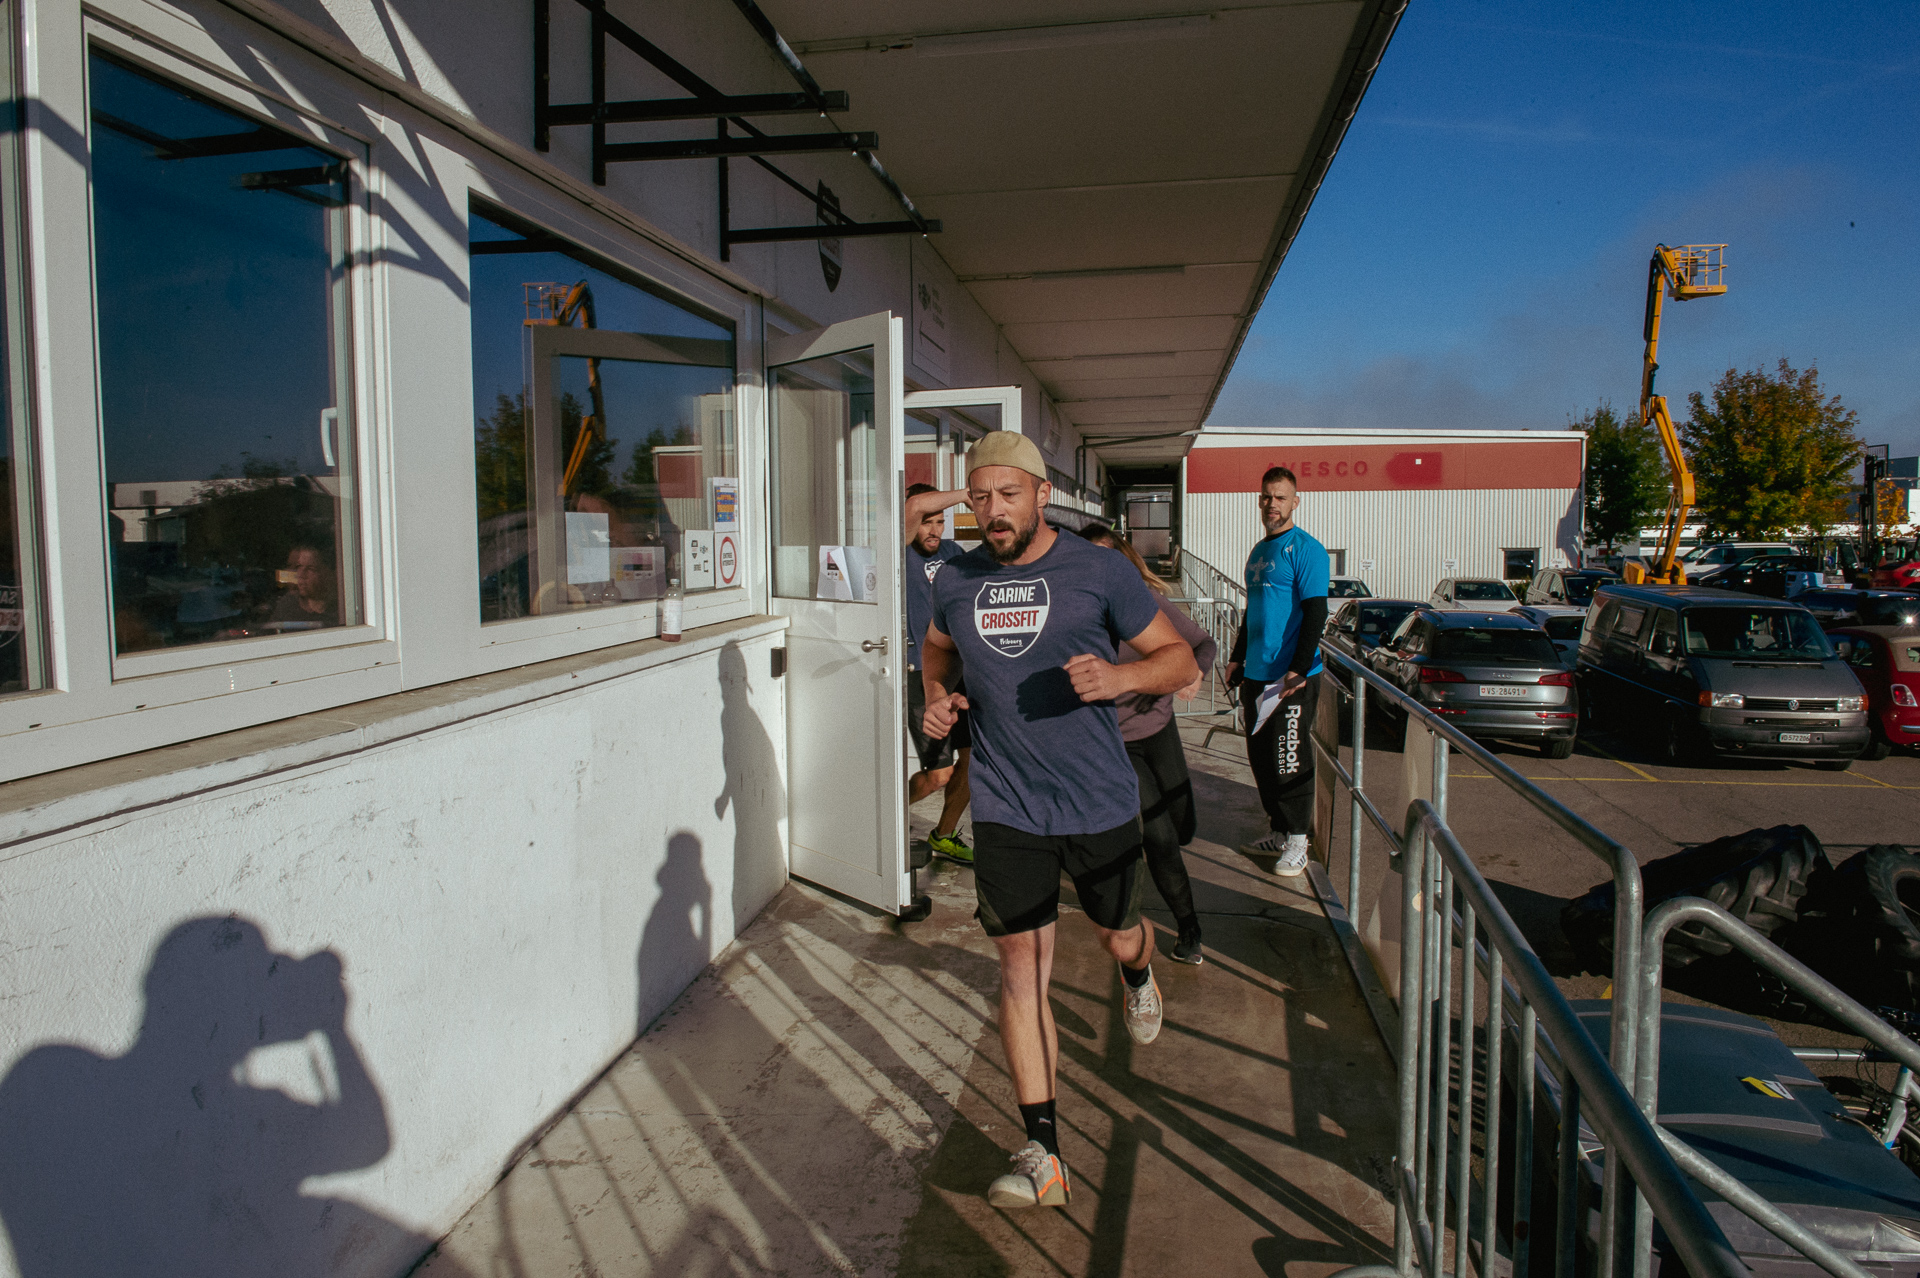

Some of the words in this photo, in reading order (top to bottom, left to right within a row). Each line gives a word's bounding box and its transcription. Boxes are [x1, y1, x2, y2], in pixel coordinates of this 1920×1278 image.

[988, 586, 1036, 604] SARINE
[981, 610, 1040, 629] CROSSFIT
[1285, 705, 1301, 773] Reebok
[1278, 735, 1286, 775] CLASSIC
